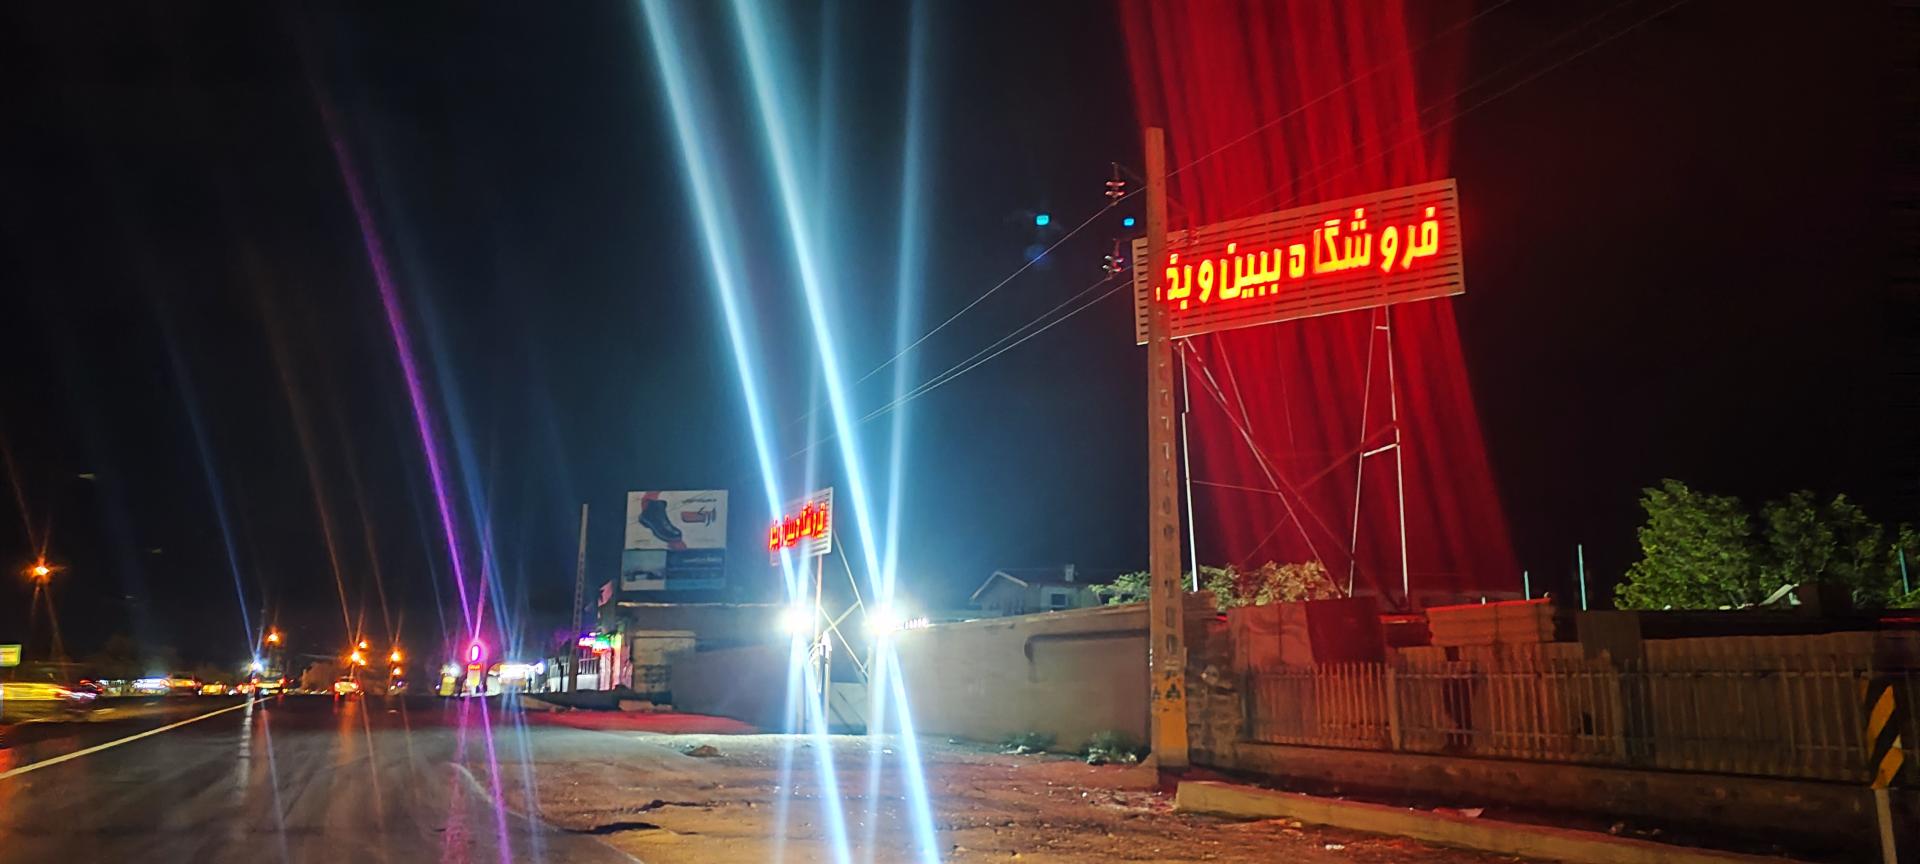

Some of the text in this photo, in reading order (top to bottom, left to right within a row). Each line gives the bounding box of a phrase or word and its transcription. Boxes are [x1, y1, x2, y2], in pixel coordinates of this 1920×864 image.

[1155, 206, 1439, 310] فروشگاه ببین و بخ
